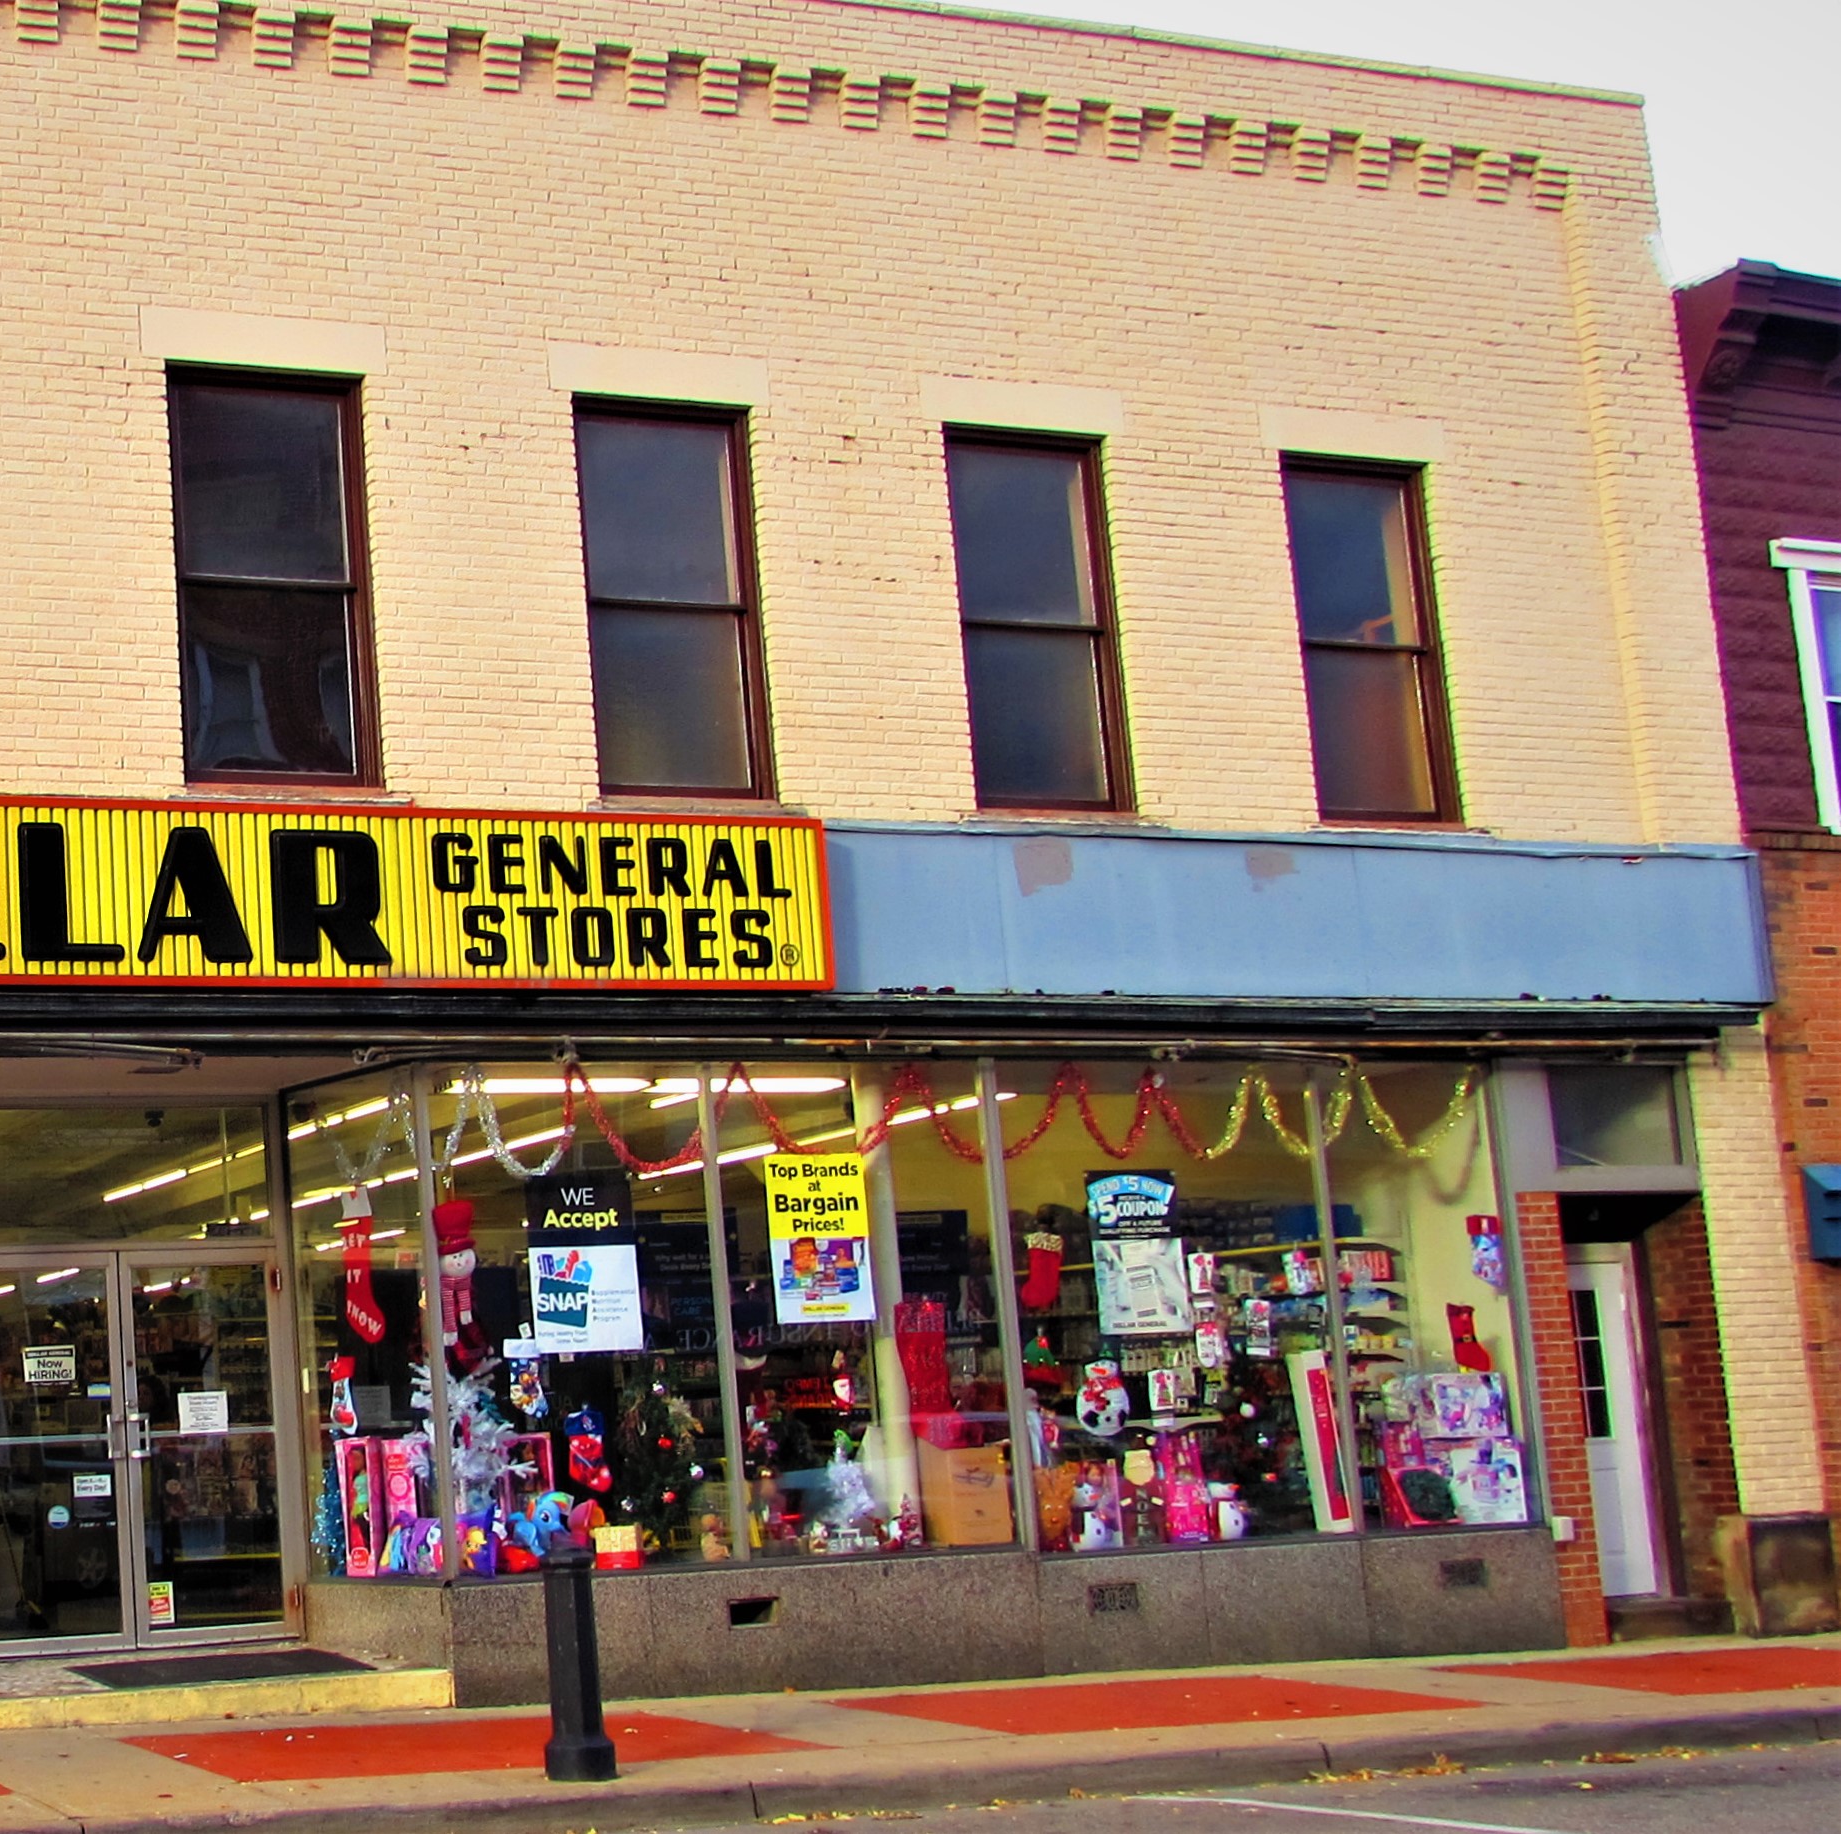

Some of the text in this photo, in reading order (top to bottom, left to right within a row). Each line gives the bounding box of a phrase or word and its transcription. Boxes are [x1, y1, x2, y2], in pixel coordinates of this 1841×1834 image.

[431, 831, 792, 899] GENERAL
[462, 904, 774, 968] STORES
[768, 1162, 858, 1180] Top Brands
[808, 1180, 821, 1192] at
[560, 1187, 595, 1206] WE
[774, 1192, 859, 1215] Bargain
[543, 1208, 619, 1231] Accept
[792, 1217, 845, 1233] Prices!
[346, 1268, 361, 1283] IT
[537, 1292, 589, 1312] SNAP
[37, 1359, 63, 1368] Now
[29, 1369, 72, 1379] HIRING!
